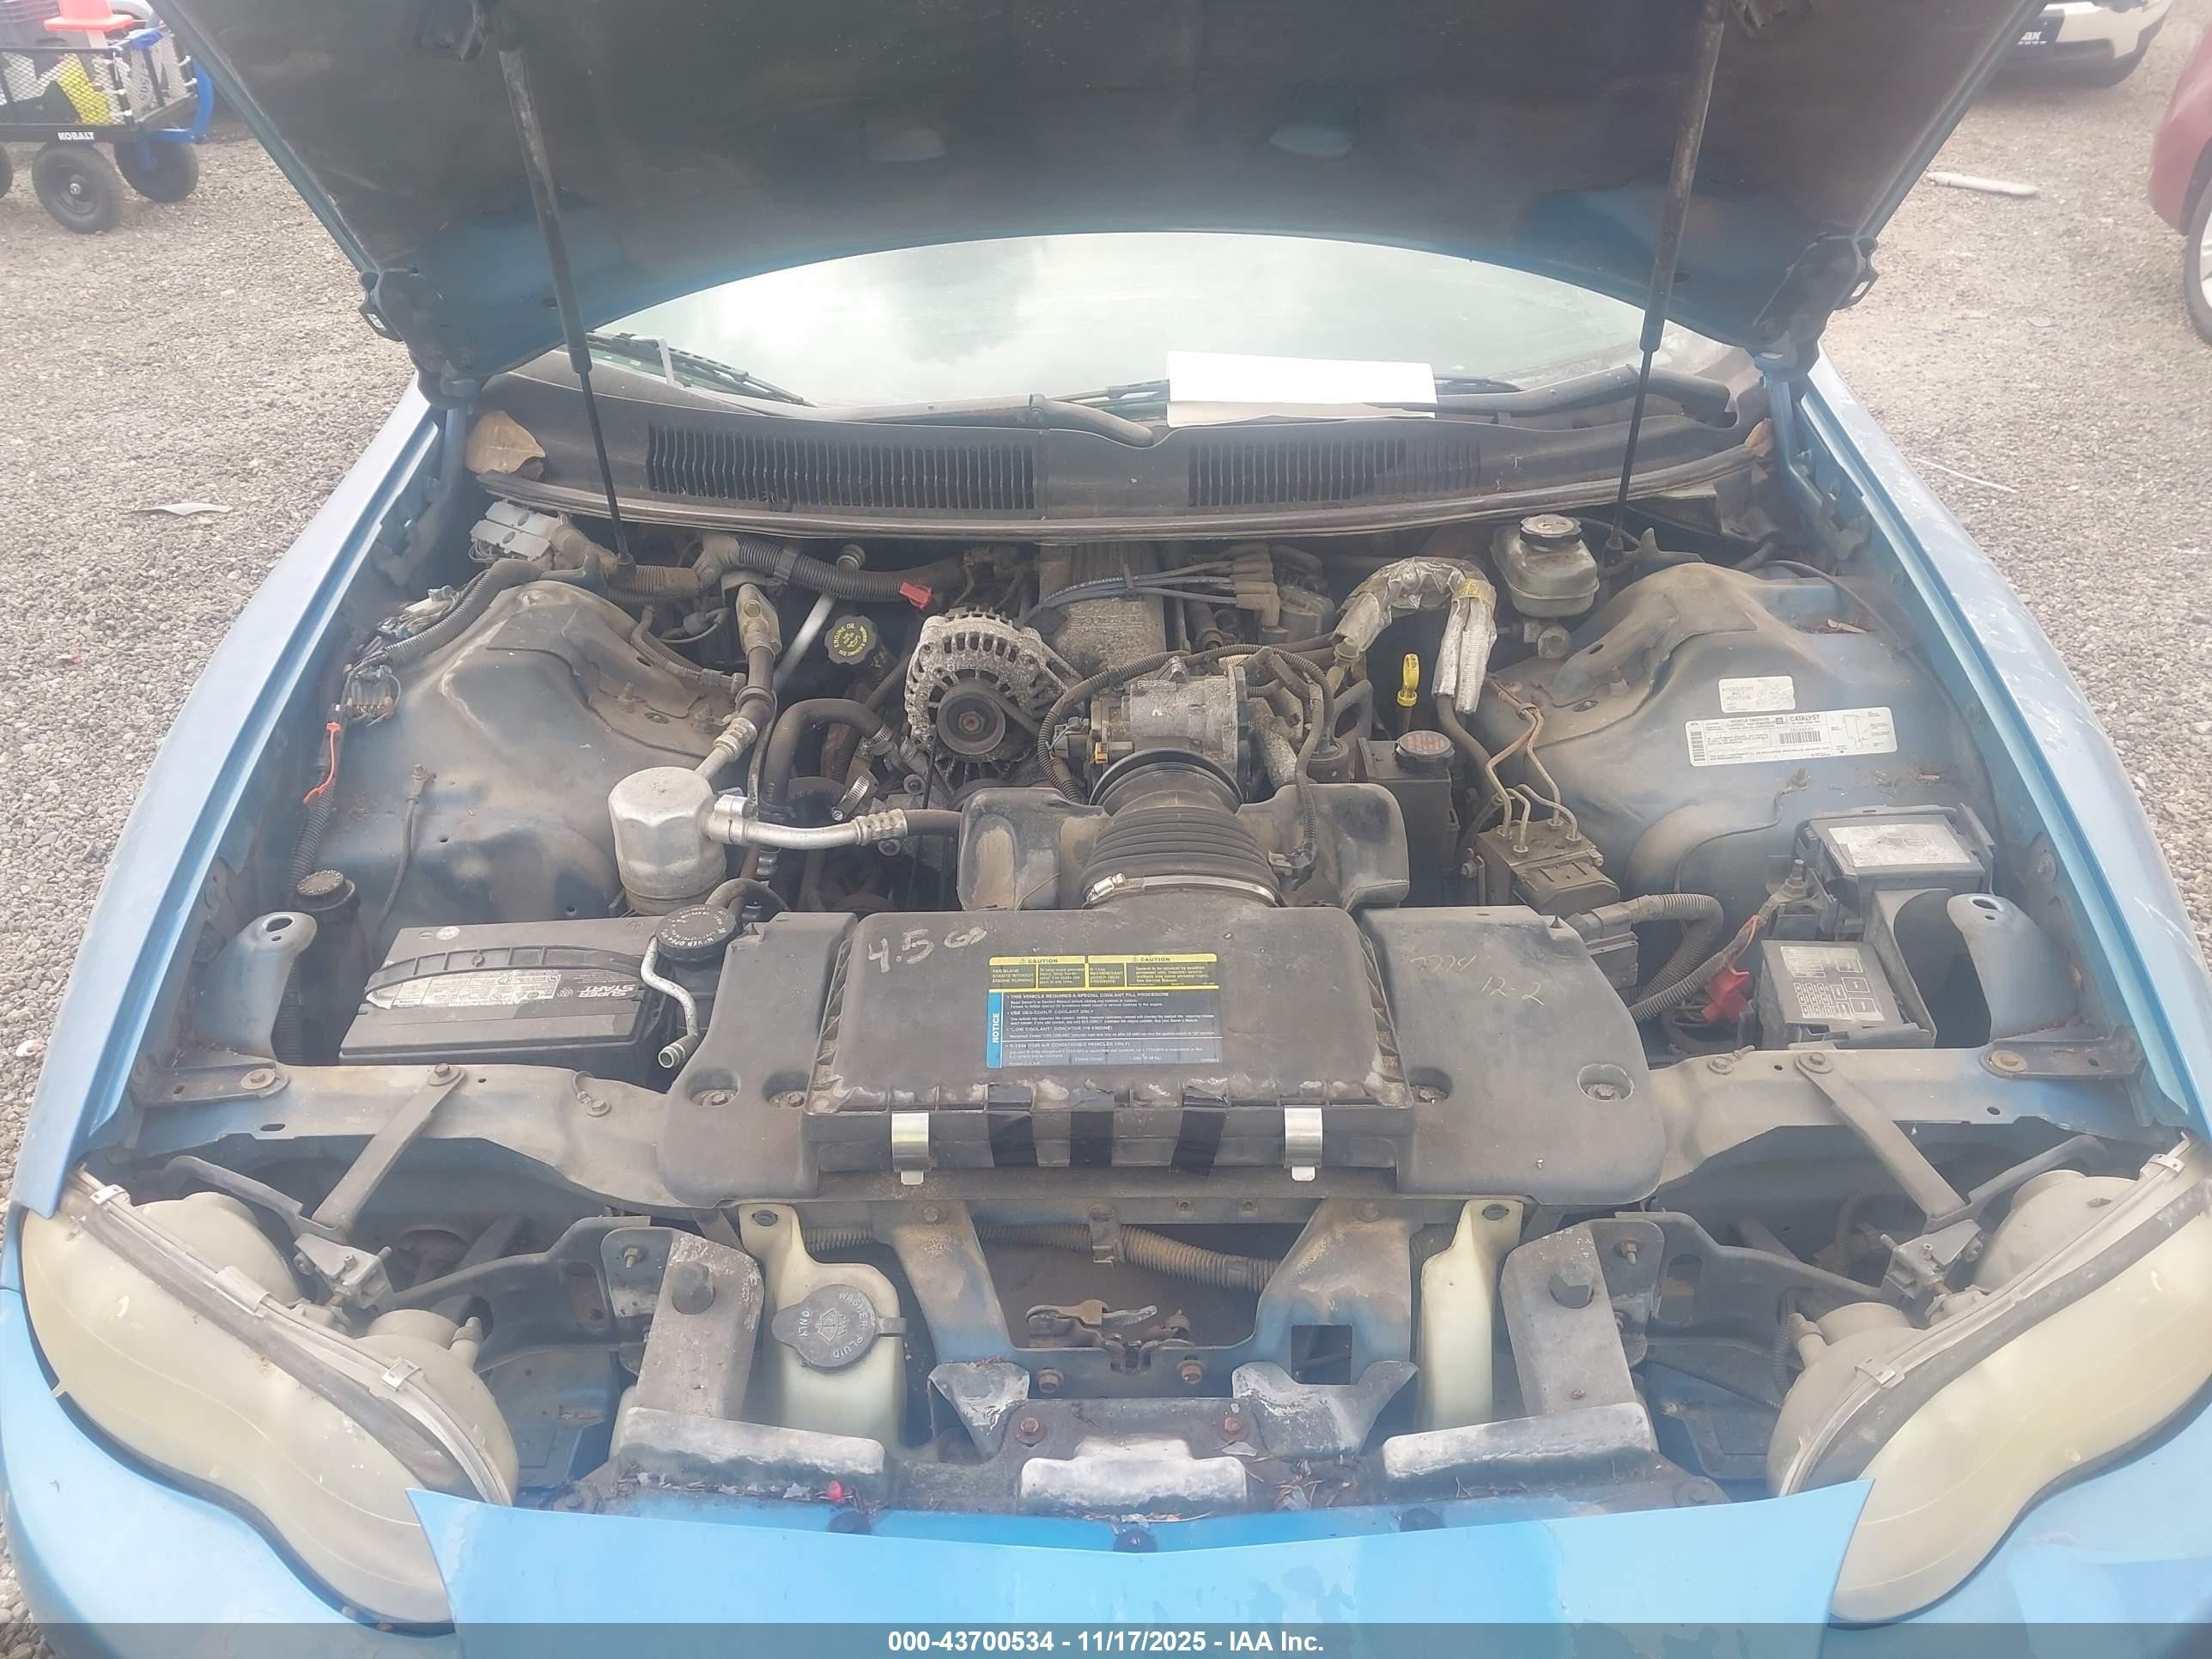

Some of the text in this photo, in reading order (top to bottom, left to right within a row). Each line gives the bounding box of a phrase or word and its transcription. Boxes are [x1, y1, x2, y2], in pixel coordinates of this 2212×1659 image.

[58, 131, 94, 141] KOBALT
[868, 928, 935, 974] 4.5
[578, 989, 627, 998] SUPER
[1480, 975, 1545, 1006] 12-2
[798, 1310, 810, 1338] ONLY
[833, 1291, 868, 1359] WASHER FLUID
